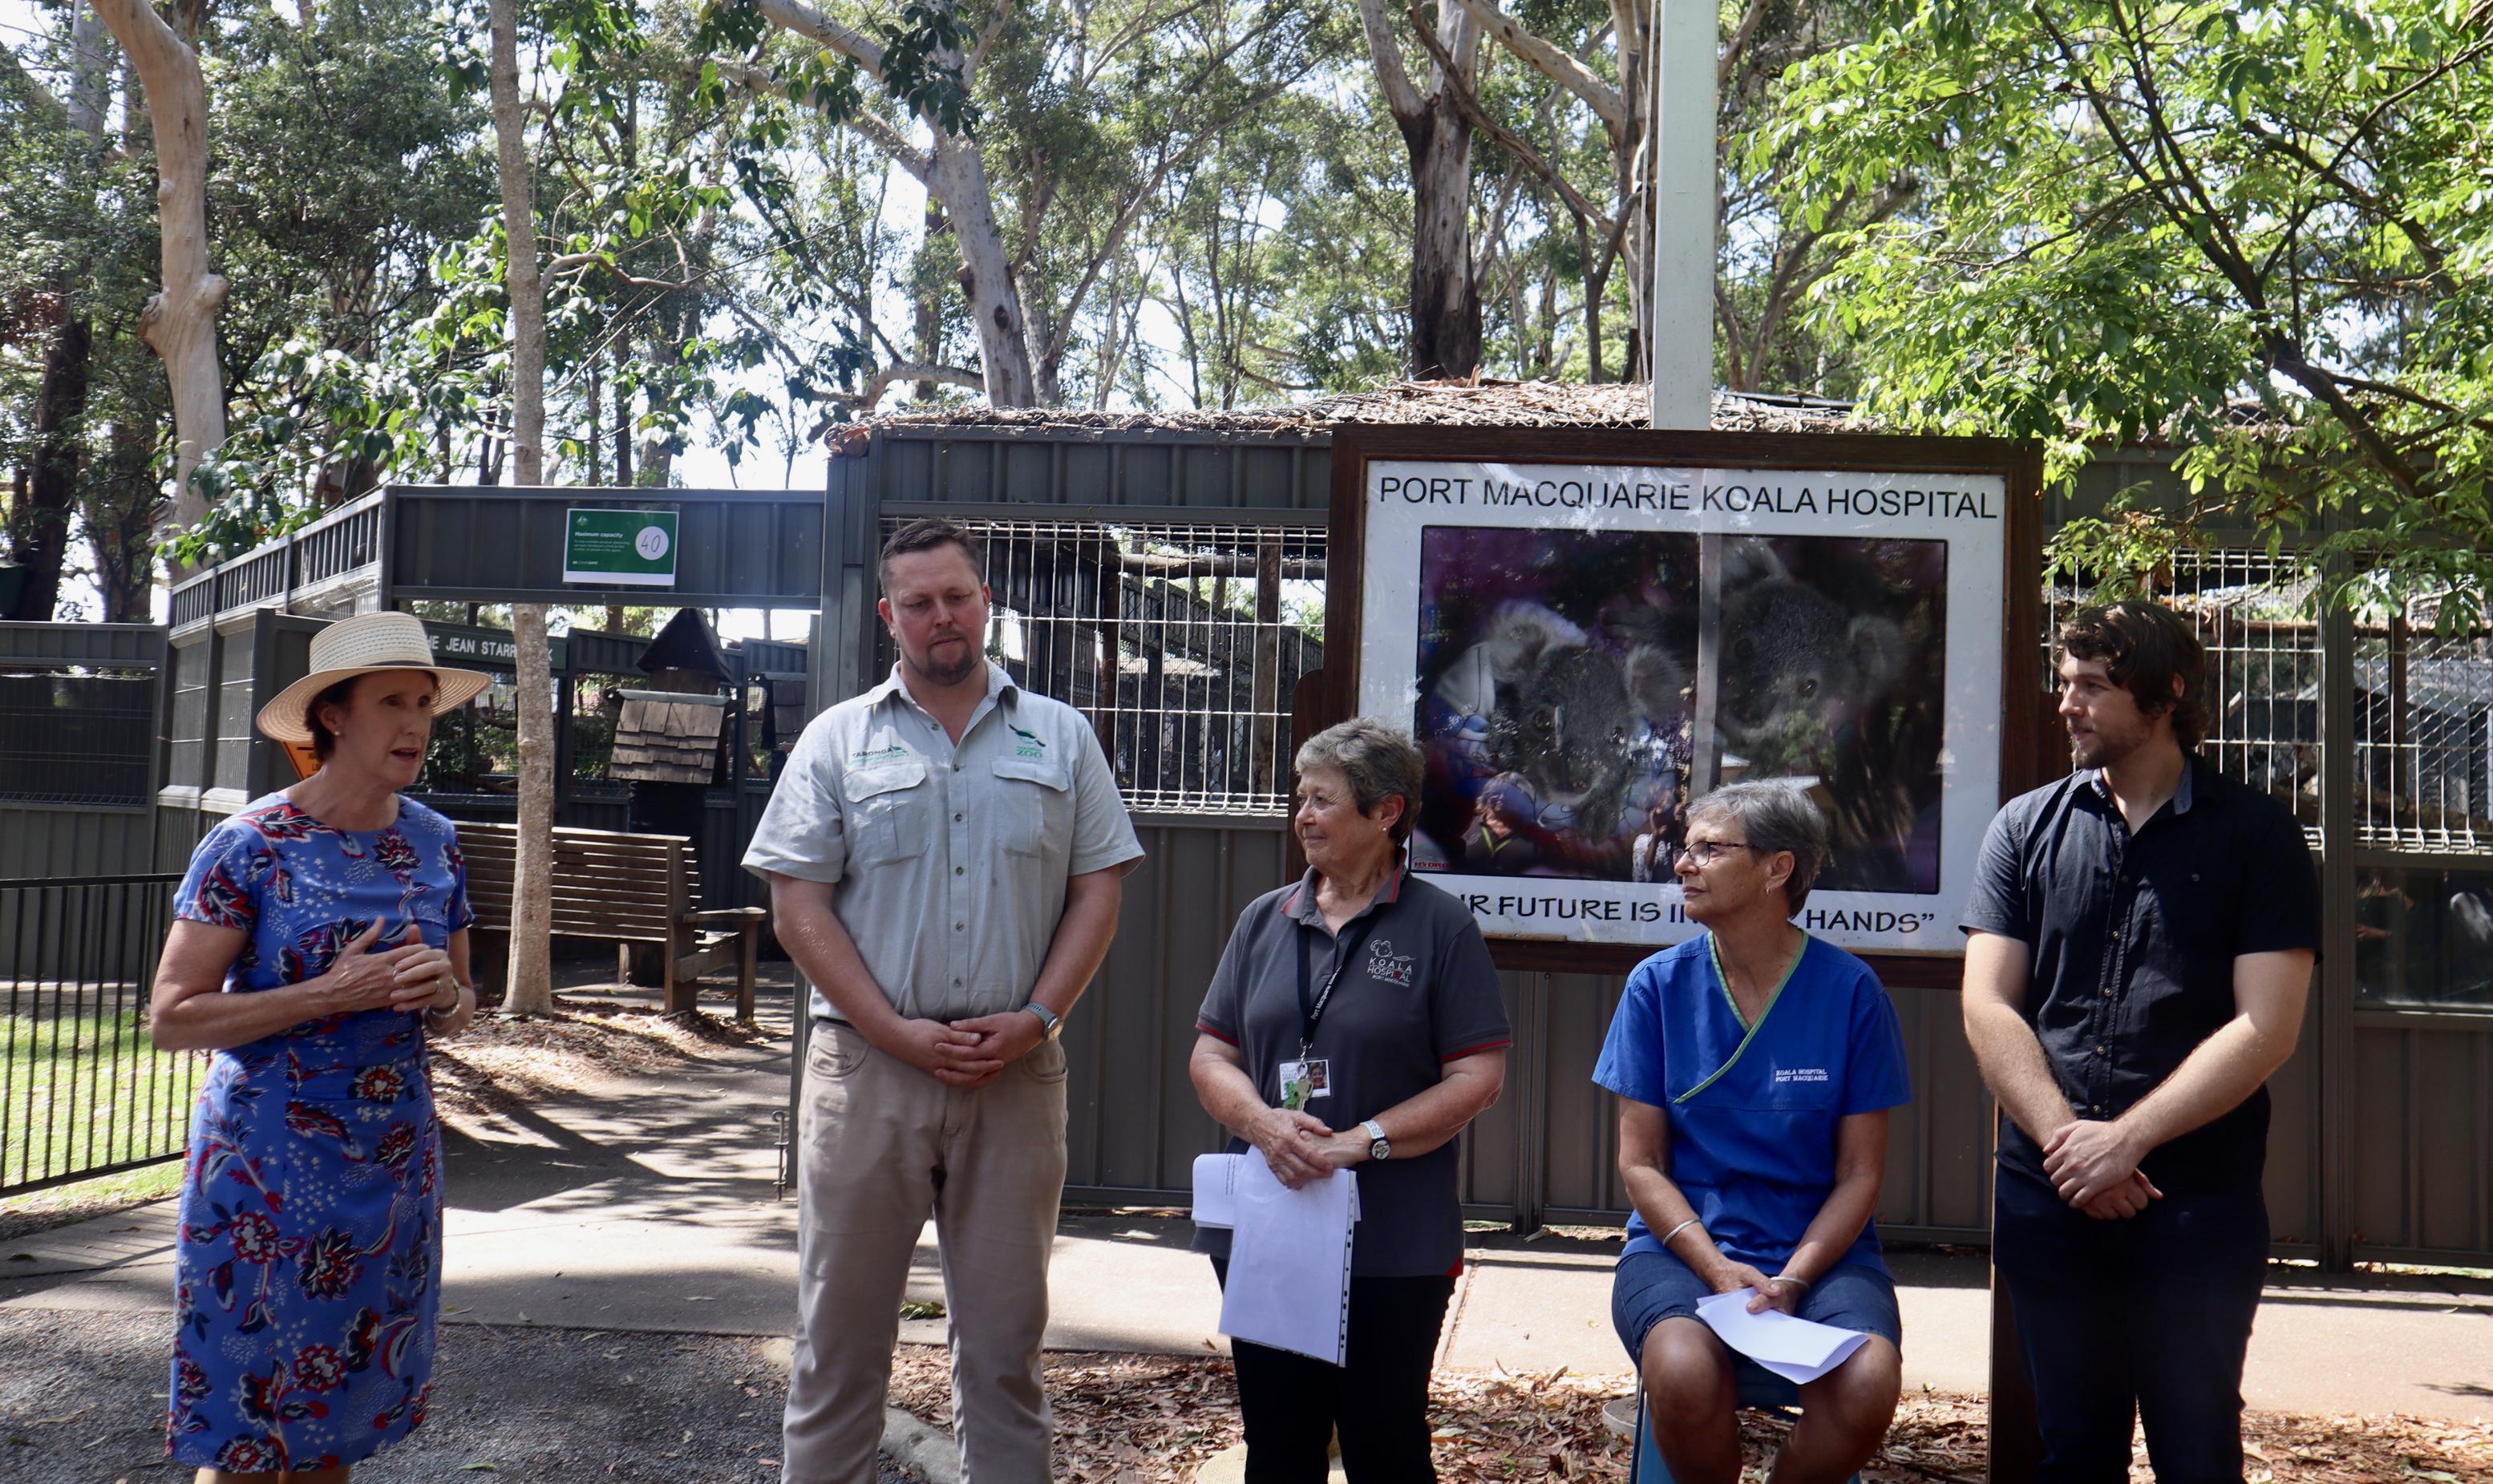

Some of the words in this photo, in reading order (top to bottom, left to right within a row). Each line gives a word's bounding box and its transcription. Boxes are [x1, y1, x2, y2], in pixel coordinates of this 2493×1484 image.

[1380, 477, 1473, 505] PORT
[1483, 479, 1690, 510] MACQUARIE
[1702, 485, 1818, 514] KOALA
[1827, 488, 1997, 520] HOSPITAL
[641, 534, 661, 552] 40
[427, 635, 439, 650] HE
[446, 637, 475, 653] JEAN
[1016, 750, 1042, 758] ZOO
[1498, 896, 1621, 920] FUTURE
[1630, 901, 1661, 923] IS
[1369, 956, 1412, 975] KOALA
